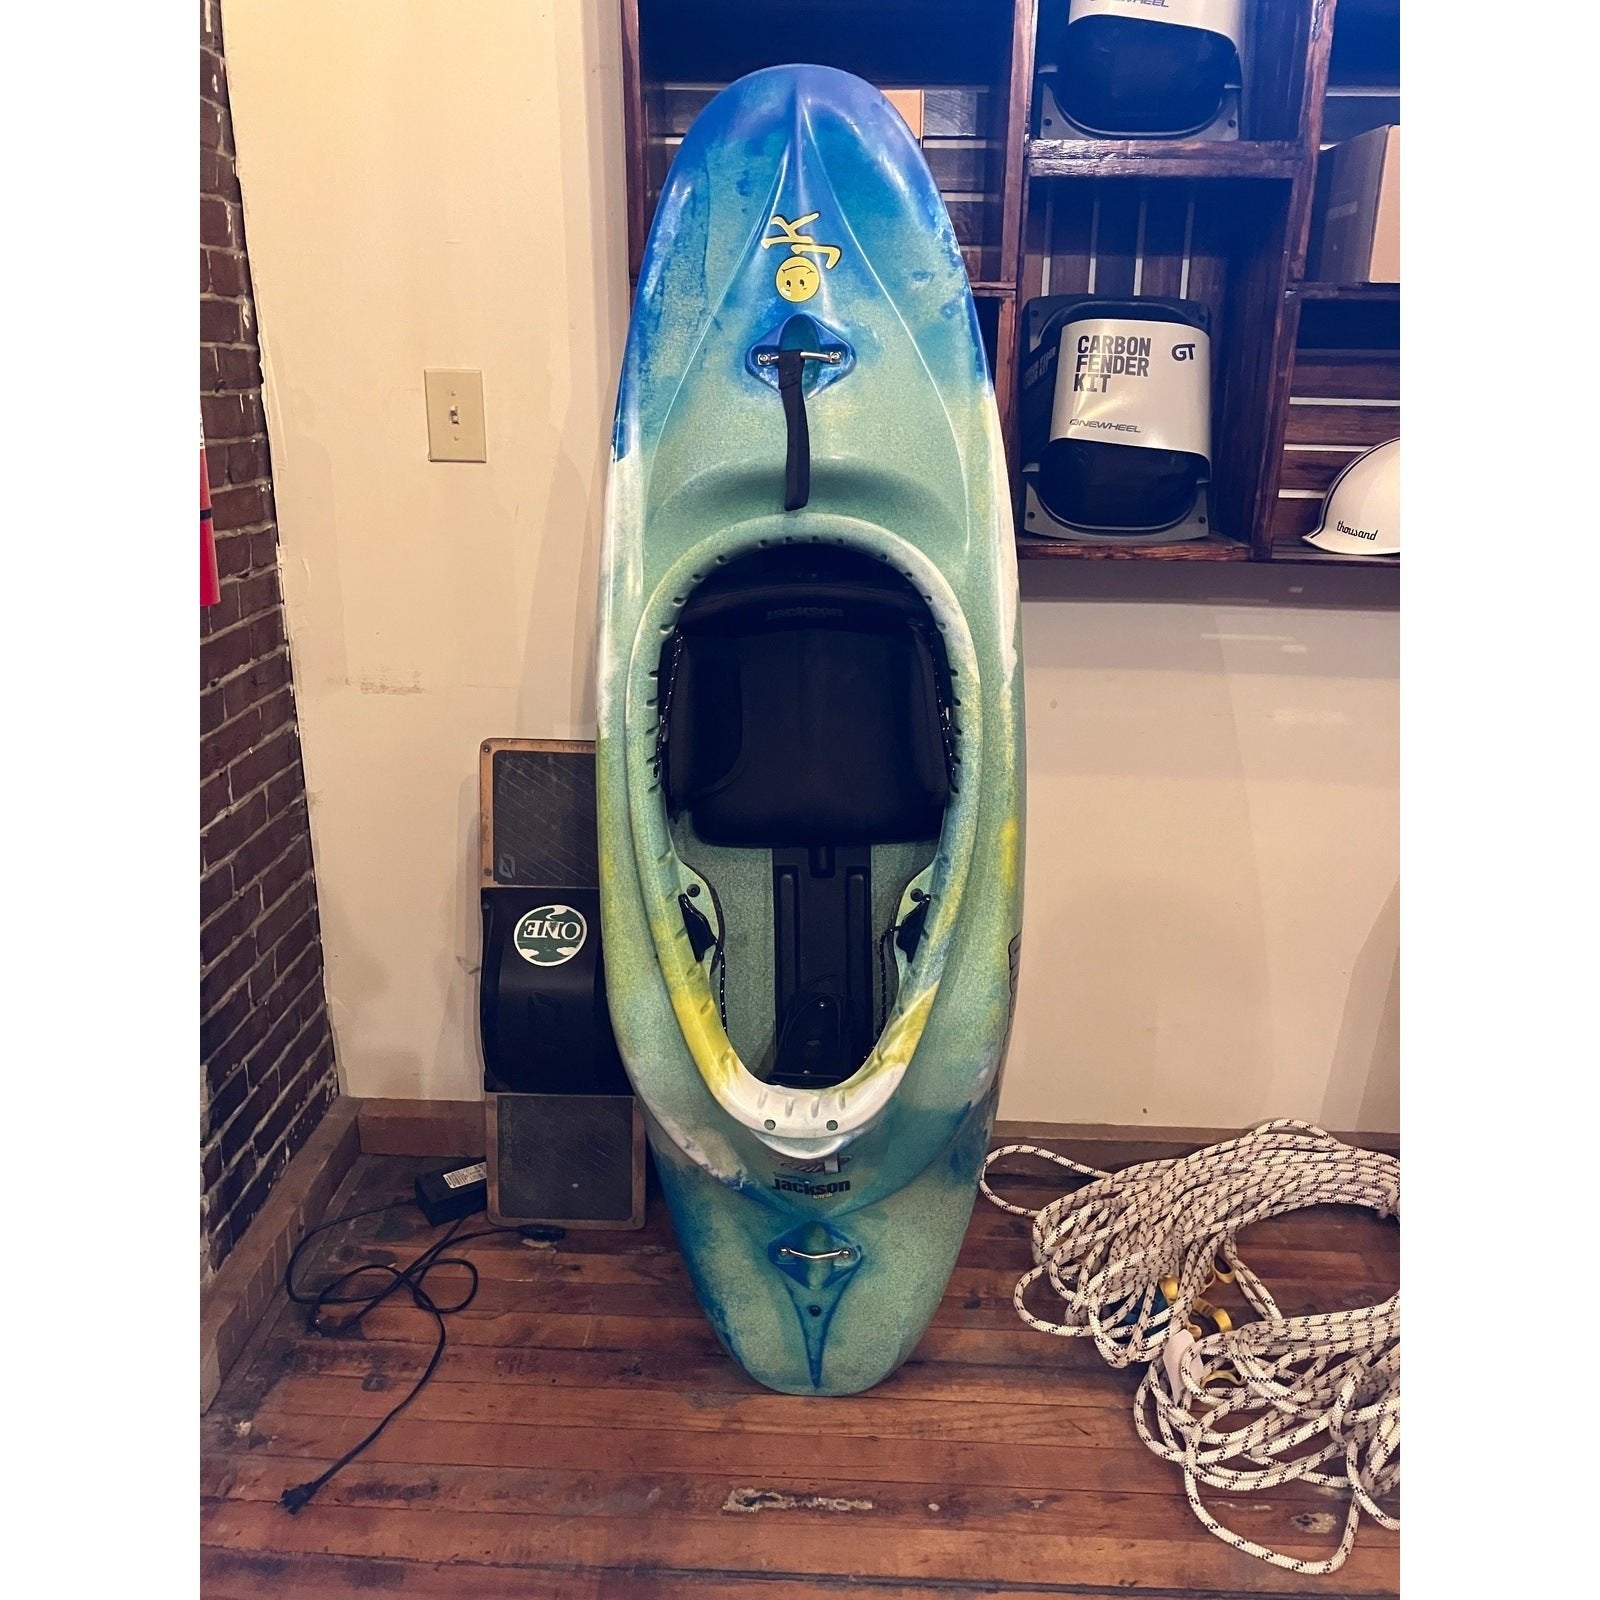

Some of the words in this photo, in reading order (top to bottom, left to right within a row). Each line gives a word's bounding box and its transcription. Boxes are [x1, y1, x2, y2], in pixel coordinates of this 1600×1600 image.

[1077, 335, 1151, 357] CARBON
[1171, 343, 1196, 361] GT
[1076, 354, 1150, 377] FENDER
[1073, 373, 1111, 393] KIT
[1069, 418, 1142, 433] ONEWHEEL
[1336, 520, 1378, 541] thousand
